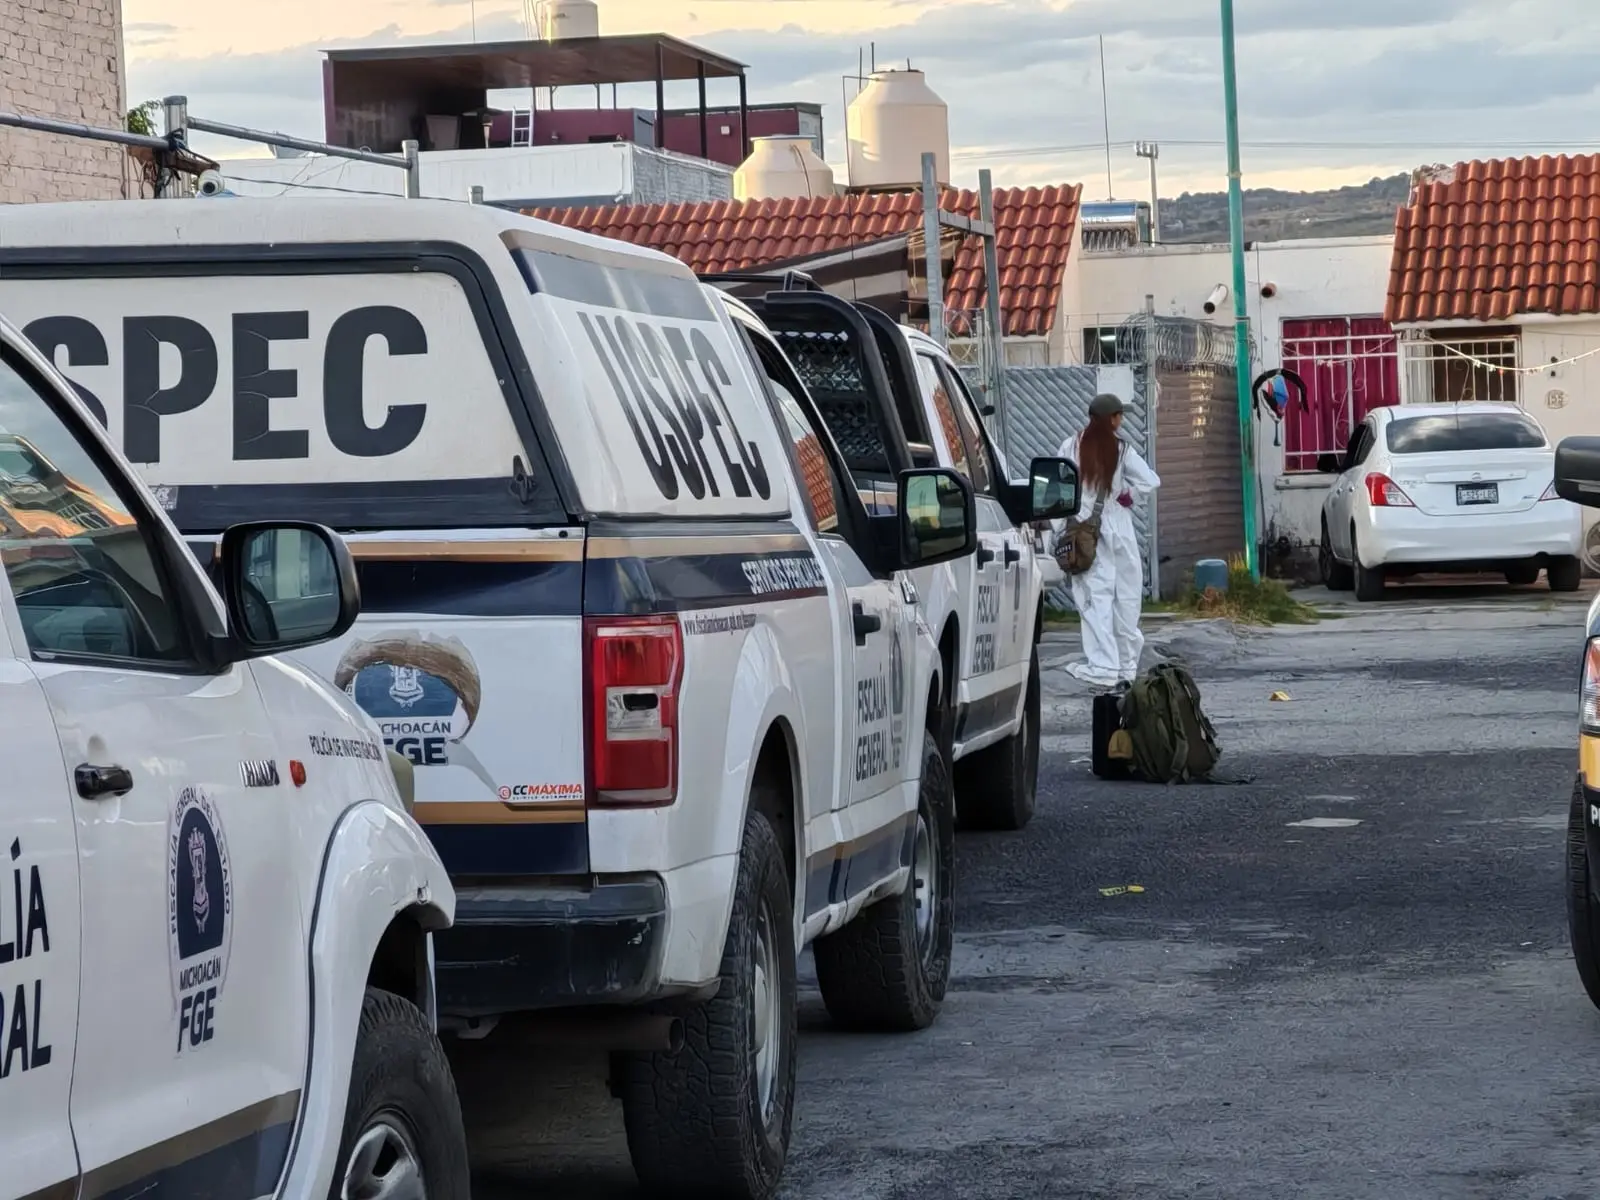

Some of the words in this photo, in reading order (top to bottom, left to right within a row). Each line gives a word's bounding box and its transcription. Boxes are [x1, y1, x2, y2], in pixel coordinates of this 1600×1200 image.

[576, 311, 771, 500] USPEC
[379, 719, 451, 734] CHOACÁN
[383, 736, 448, 766] GE
[855, 728, 888, 782] GENERAL
[180, 955, 222, 992] MICHOACÁN
[0, 979, 52, 1079] AL
[177, 986, 217, 1053] FGE
